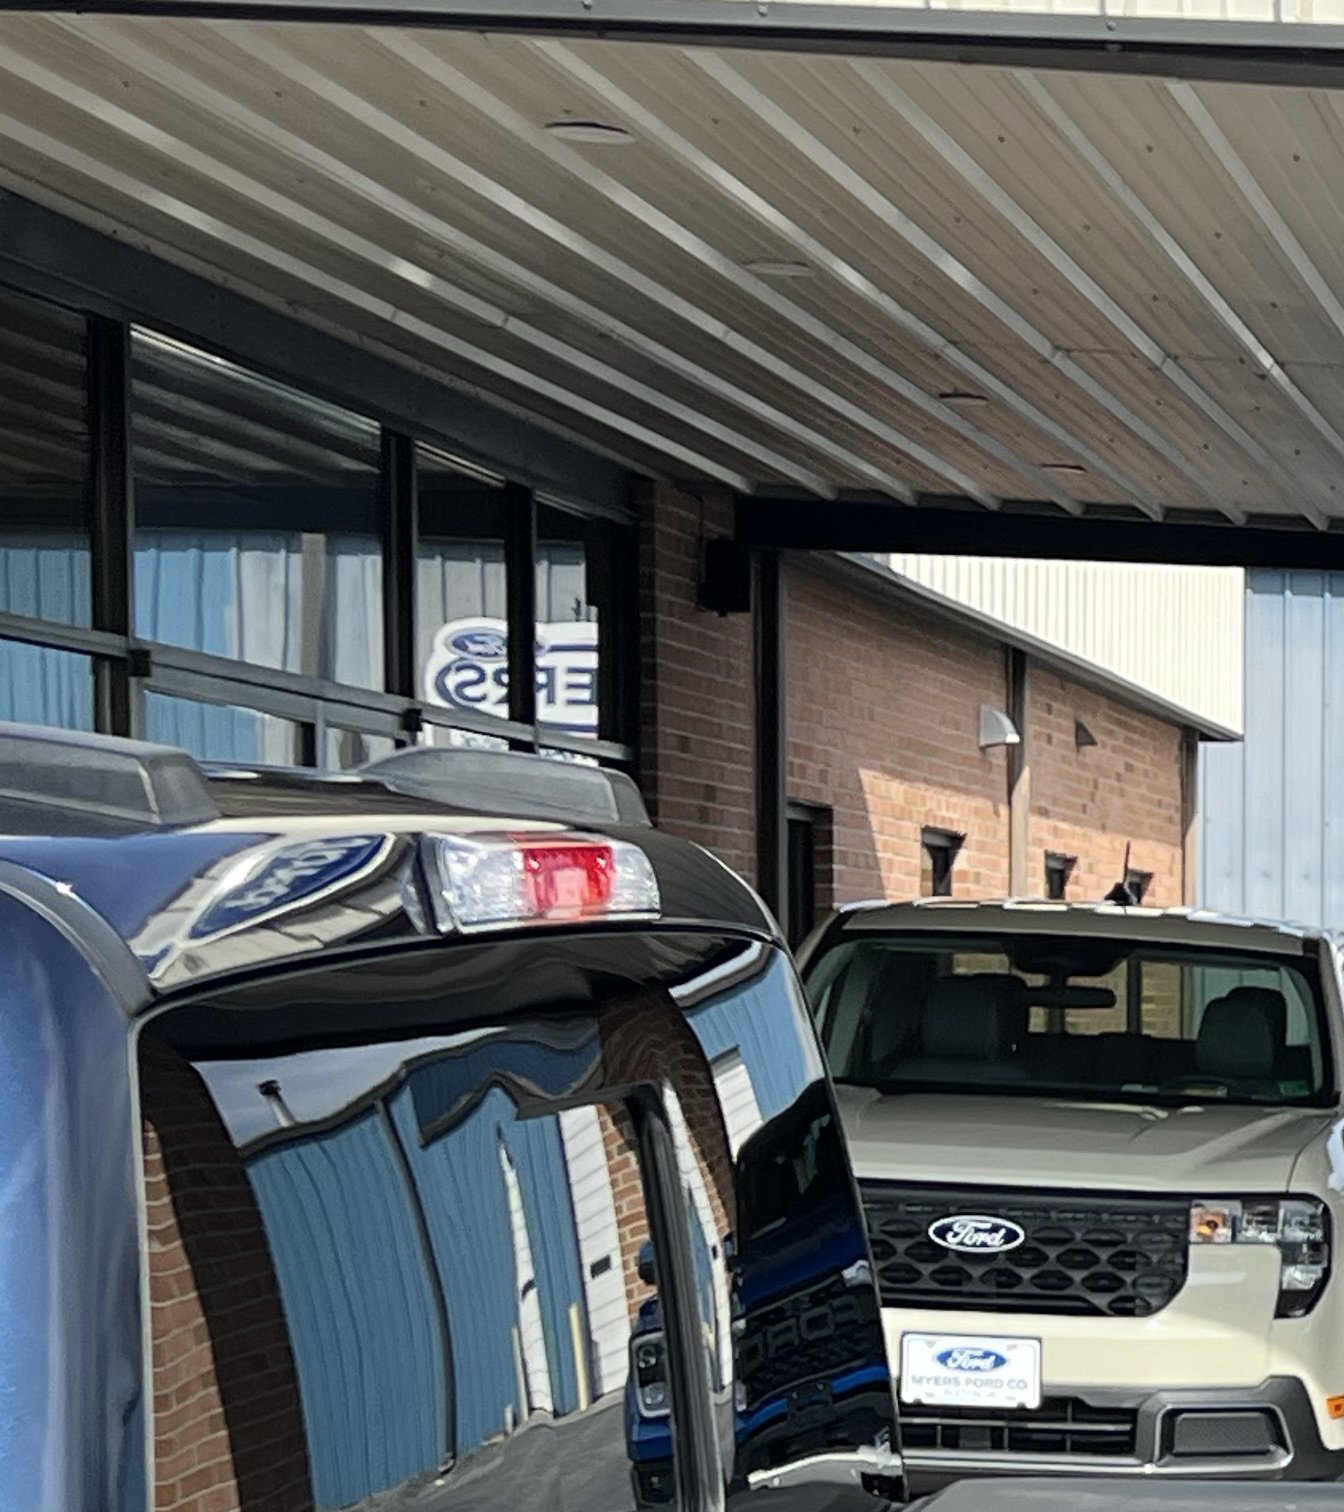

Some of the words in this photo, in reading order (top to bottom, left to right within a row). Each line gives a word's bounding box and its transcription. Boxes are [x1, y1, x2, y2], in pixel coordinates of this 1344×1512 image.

[945, 1221, 1006, 1246] Ford
[947, 1349, 996, 1370] Ford
[911, 1374, 961, 1387] MYERS
[964, 1377, 1004, 1388] FORD
[1006, 1379, 1028, 1390] CO
